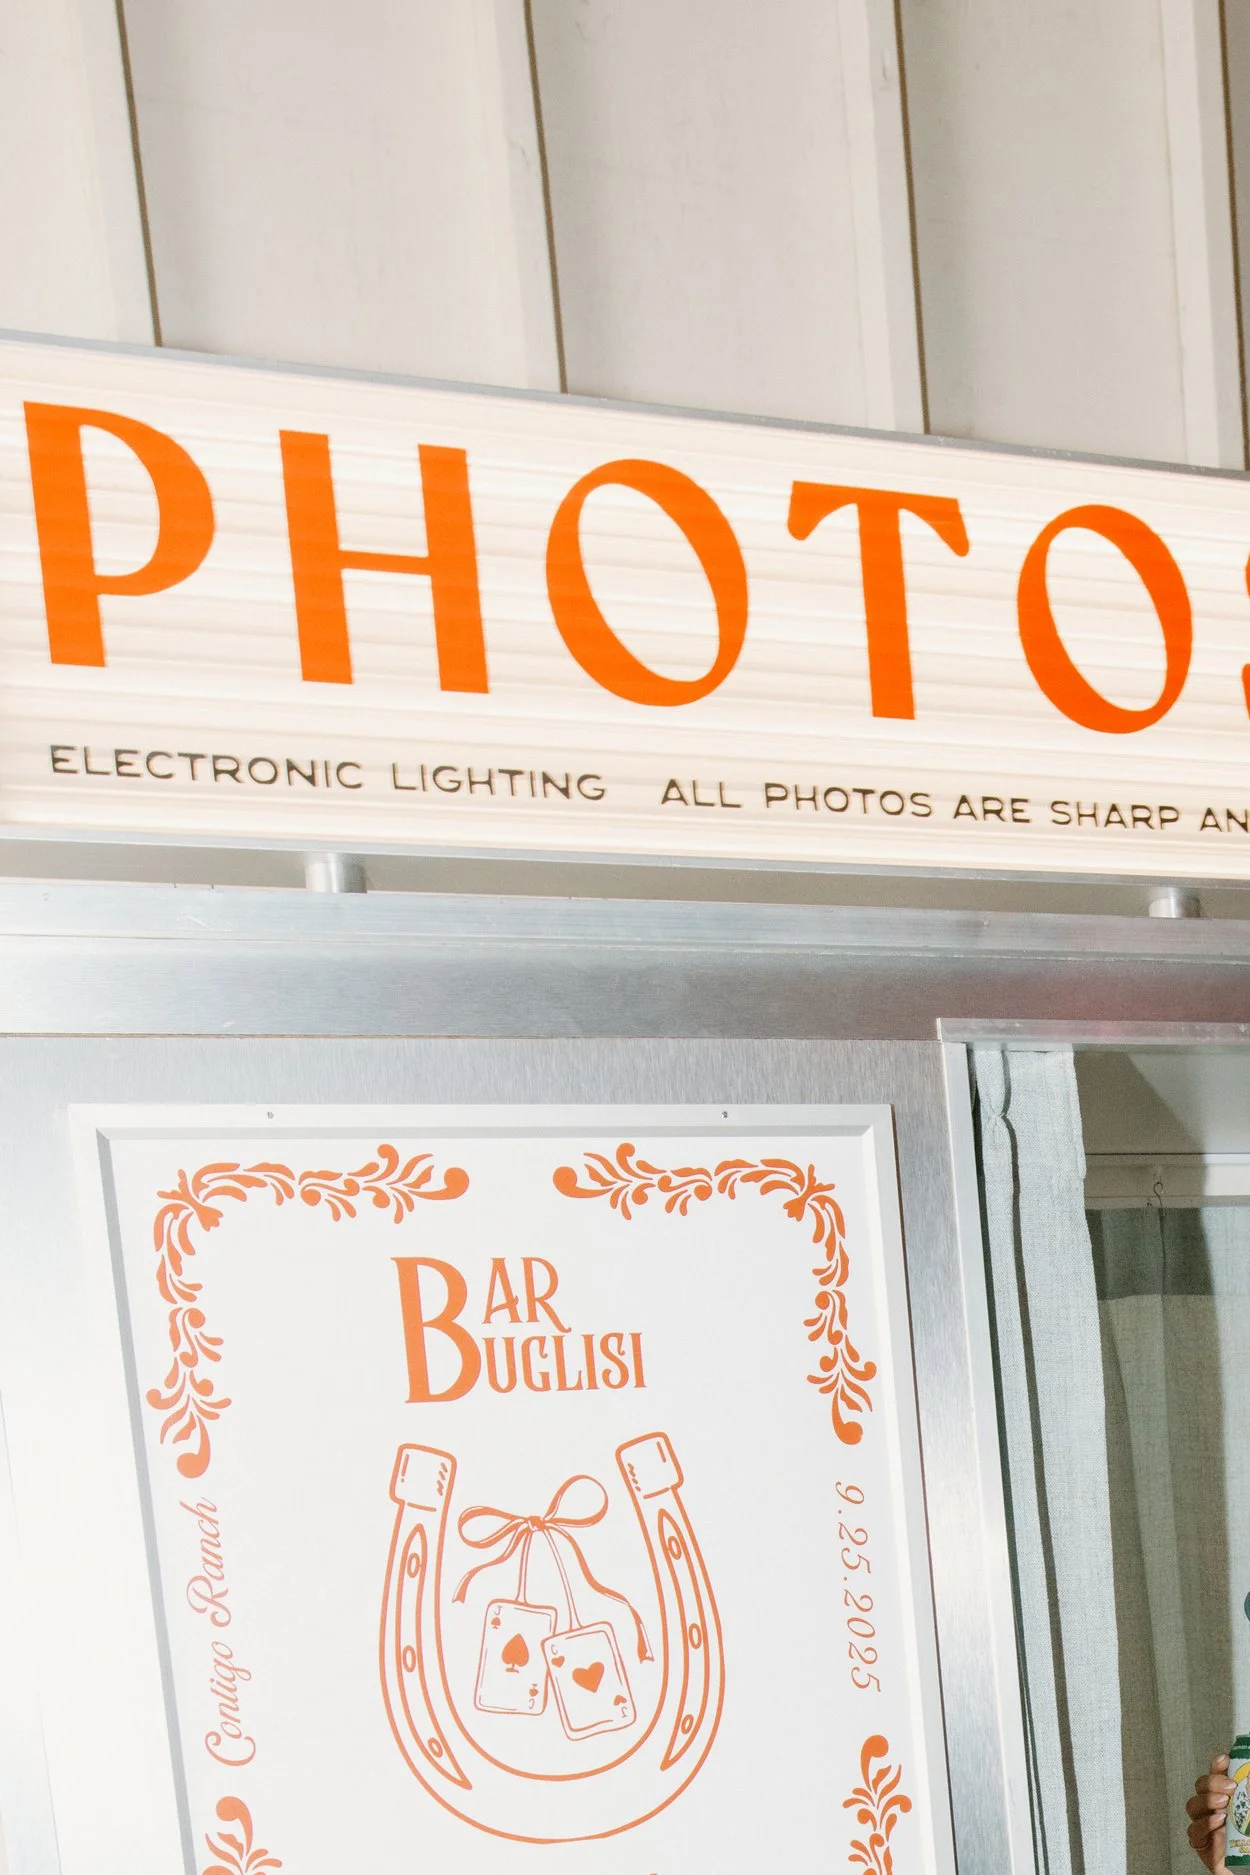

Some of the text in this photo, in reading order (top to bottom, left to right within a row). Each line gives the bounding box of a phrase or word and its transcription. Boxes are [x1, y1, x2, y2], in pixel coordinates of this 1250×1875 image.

[50, 744, 363, 789] ELECTRONIC
[392, 762, 607, 801] LIGHTING
[661, 778, 741, 809] ALL
[765, 782, 932, 817] PHOTOS
[953, 795, 1031, 825] ARE
[1050, 801, 1180, 831] SHARP
[390, 1320, 647, 1403] BUGLISI
[179, 1497, 256, 1767] Contigo Ranch
[835, 1481, 881, 1692] 9.25.2025
